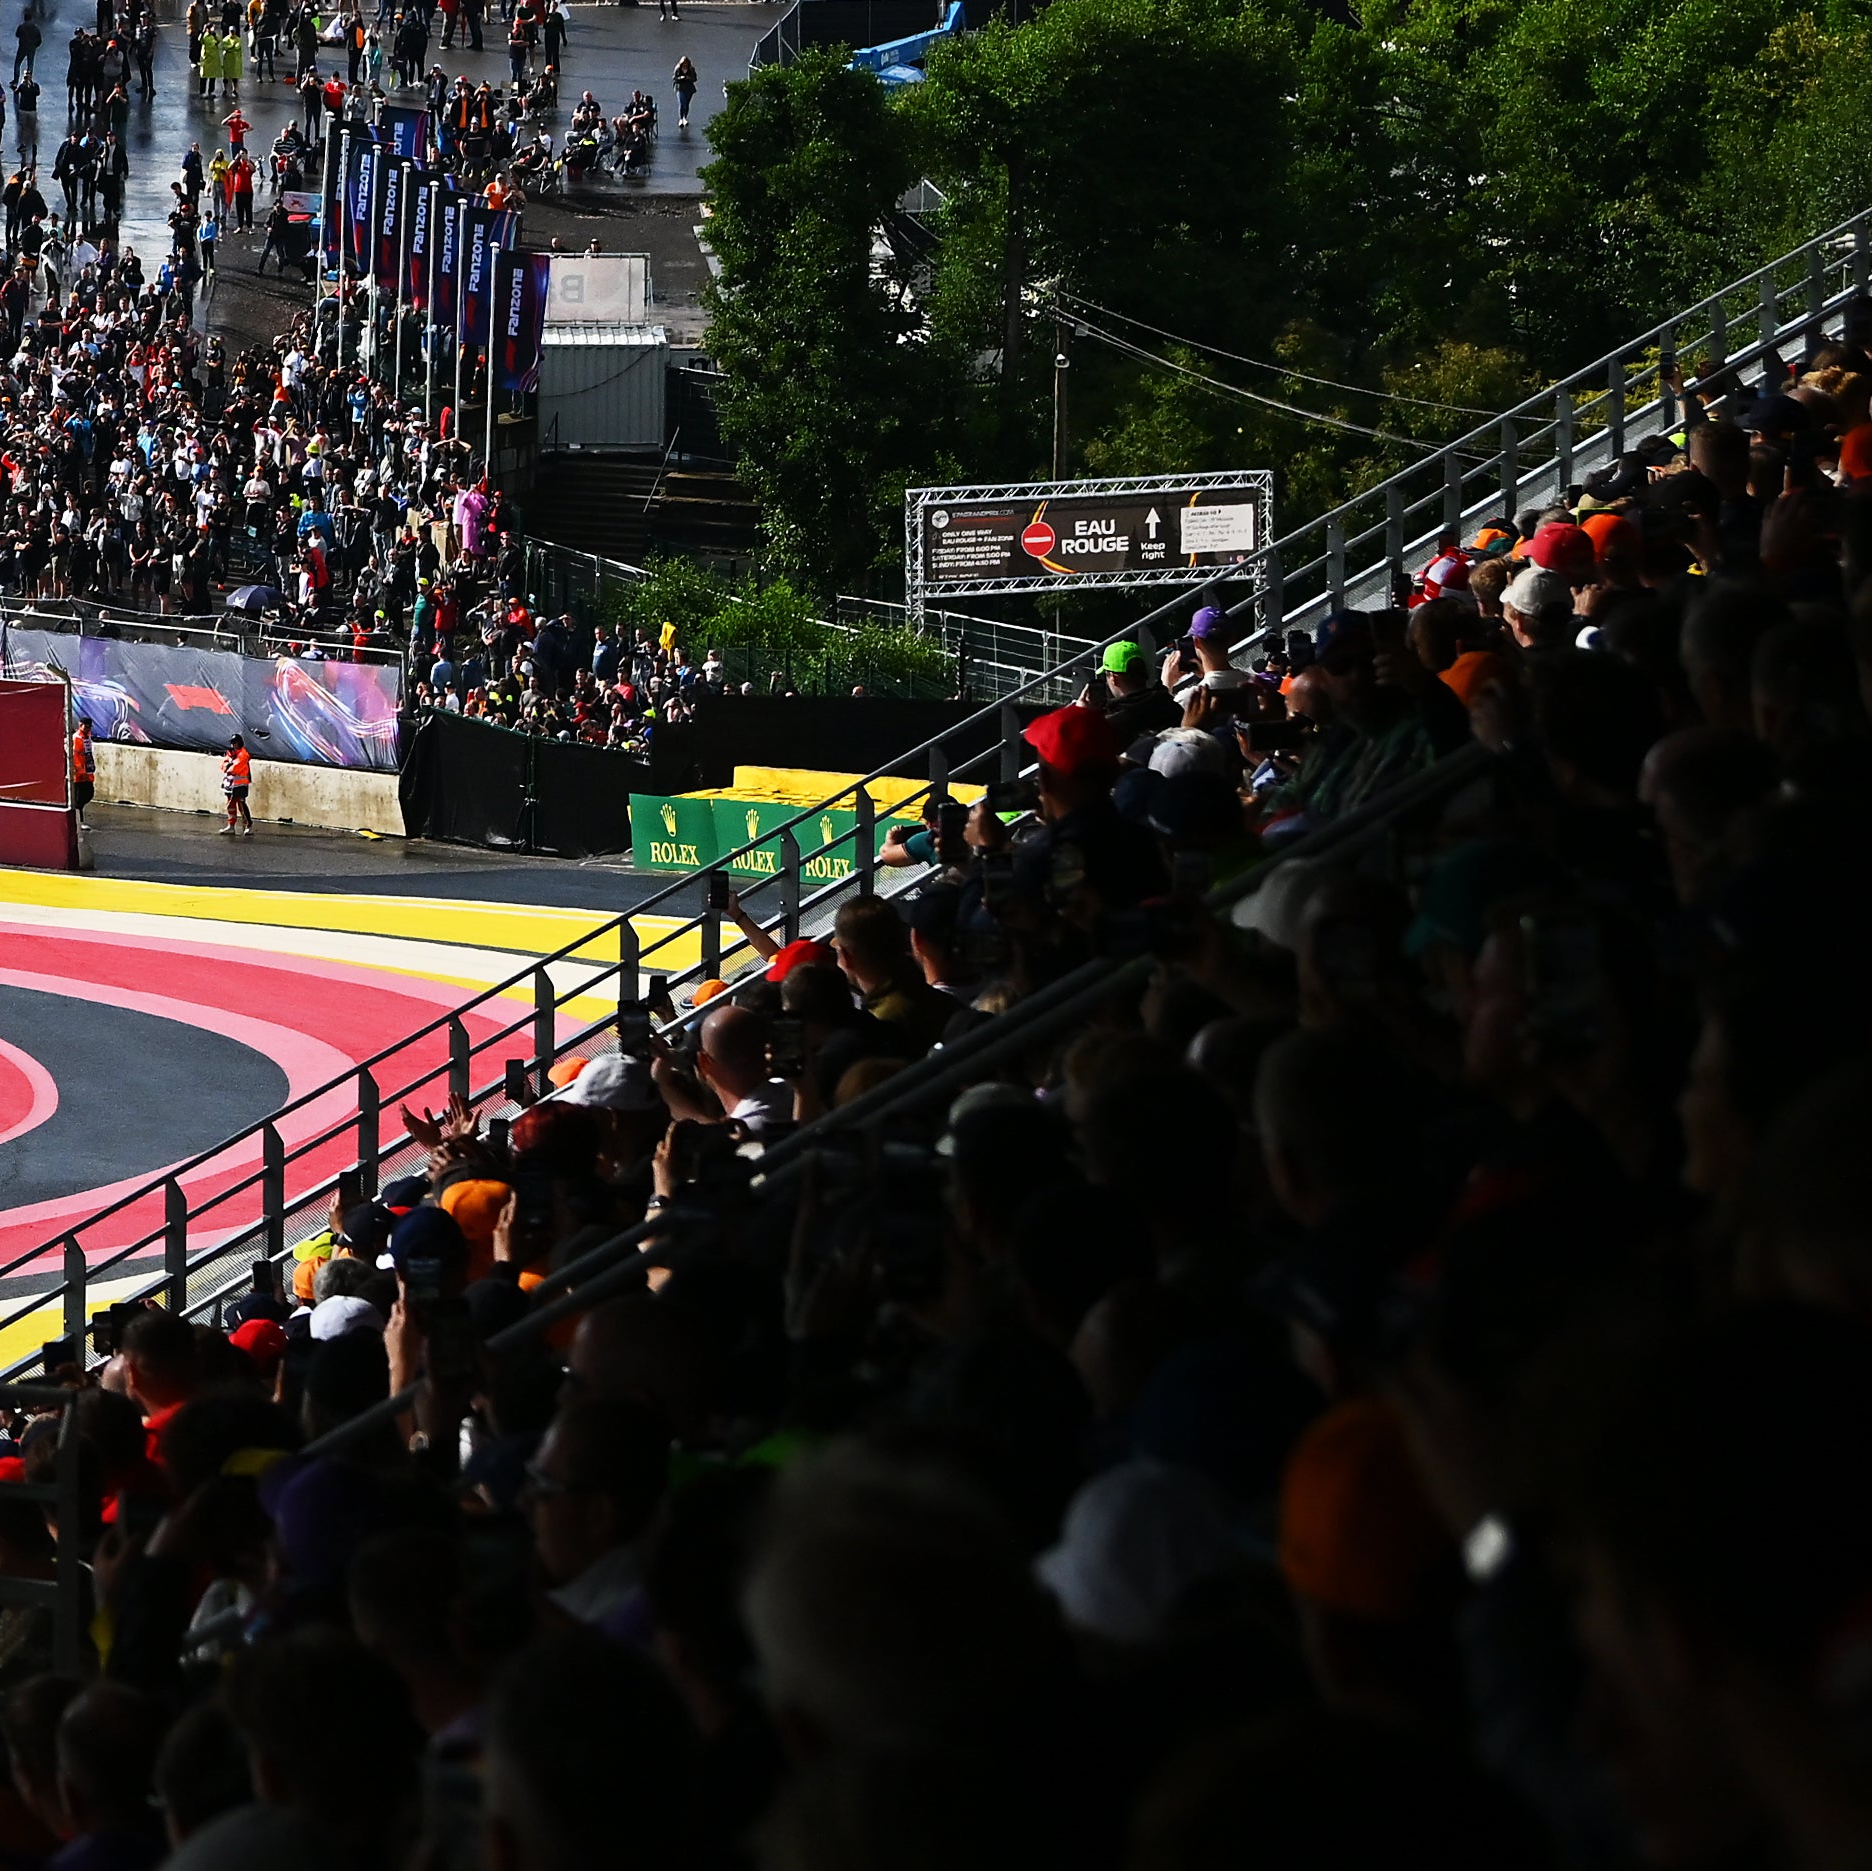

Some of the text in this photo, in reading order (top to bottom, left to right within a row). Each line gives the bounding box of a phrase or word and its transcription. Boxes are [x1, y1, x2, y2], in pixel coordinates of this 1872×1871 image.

[1075, 519, 1116, 536] EAU
[1061, 535, 1130, 555] ROUGE
[1140, 541, 1166, 553] Keep
[1141, 549, 1165, 561] right
[650, 841, 701, 866] ROLEX
